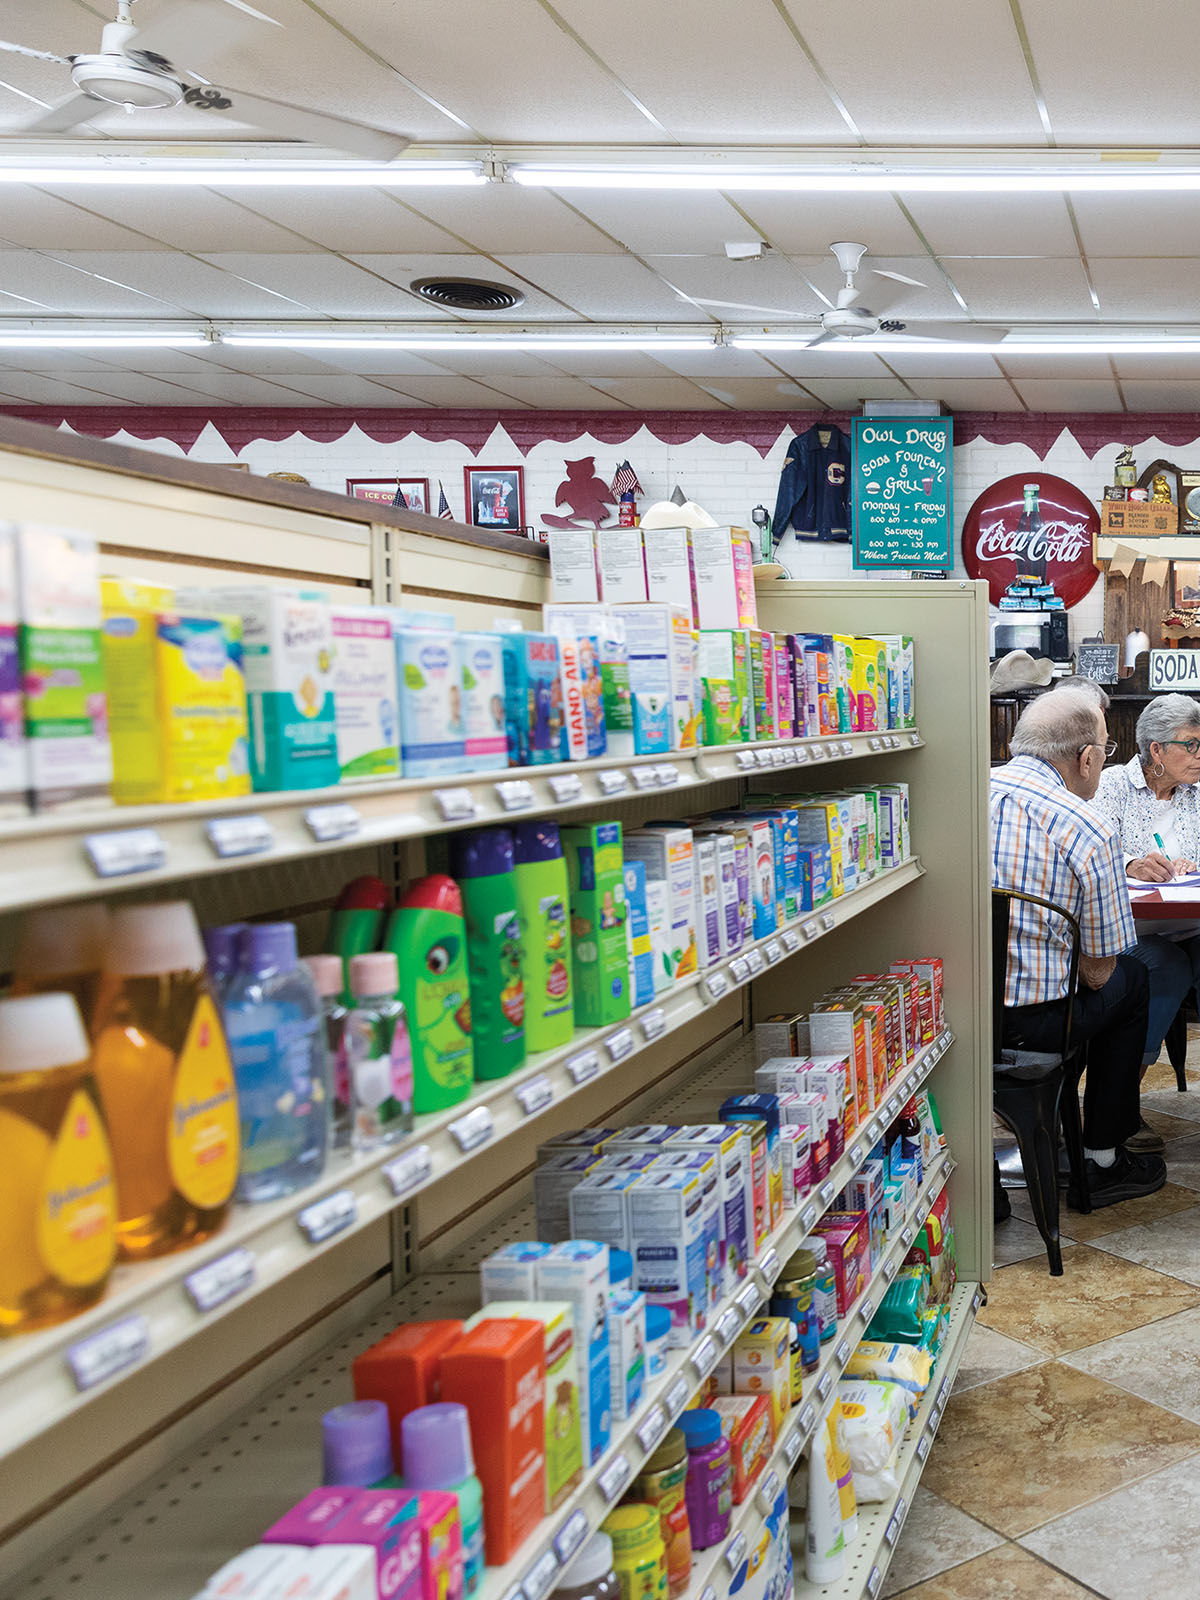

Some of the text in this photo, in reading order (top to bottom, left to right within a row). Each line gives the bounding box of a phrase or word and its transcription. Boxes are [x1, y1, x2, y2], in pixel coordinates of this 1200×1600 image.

[827, 462, 846, 486] C
[899, 463, 908, 478] &
[976, 519, 1091, 562] Coca-Cola
[890, 550, 921, 561] Friends
[1154, 654, 1198, 685] SODA
